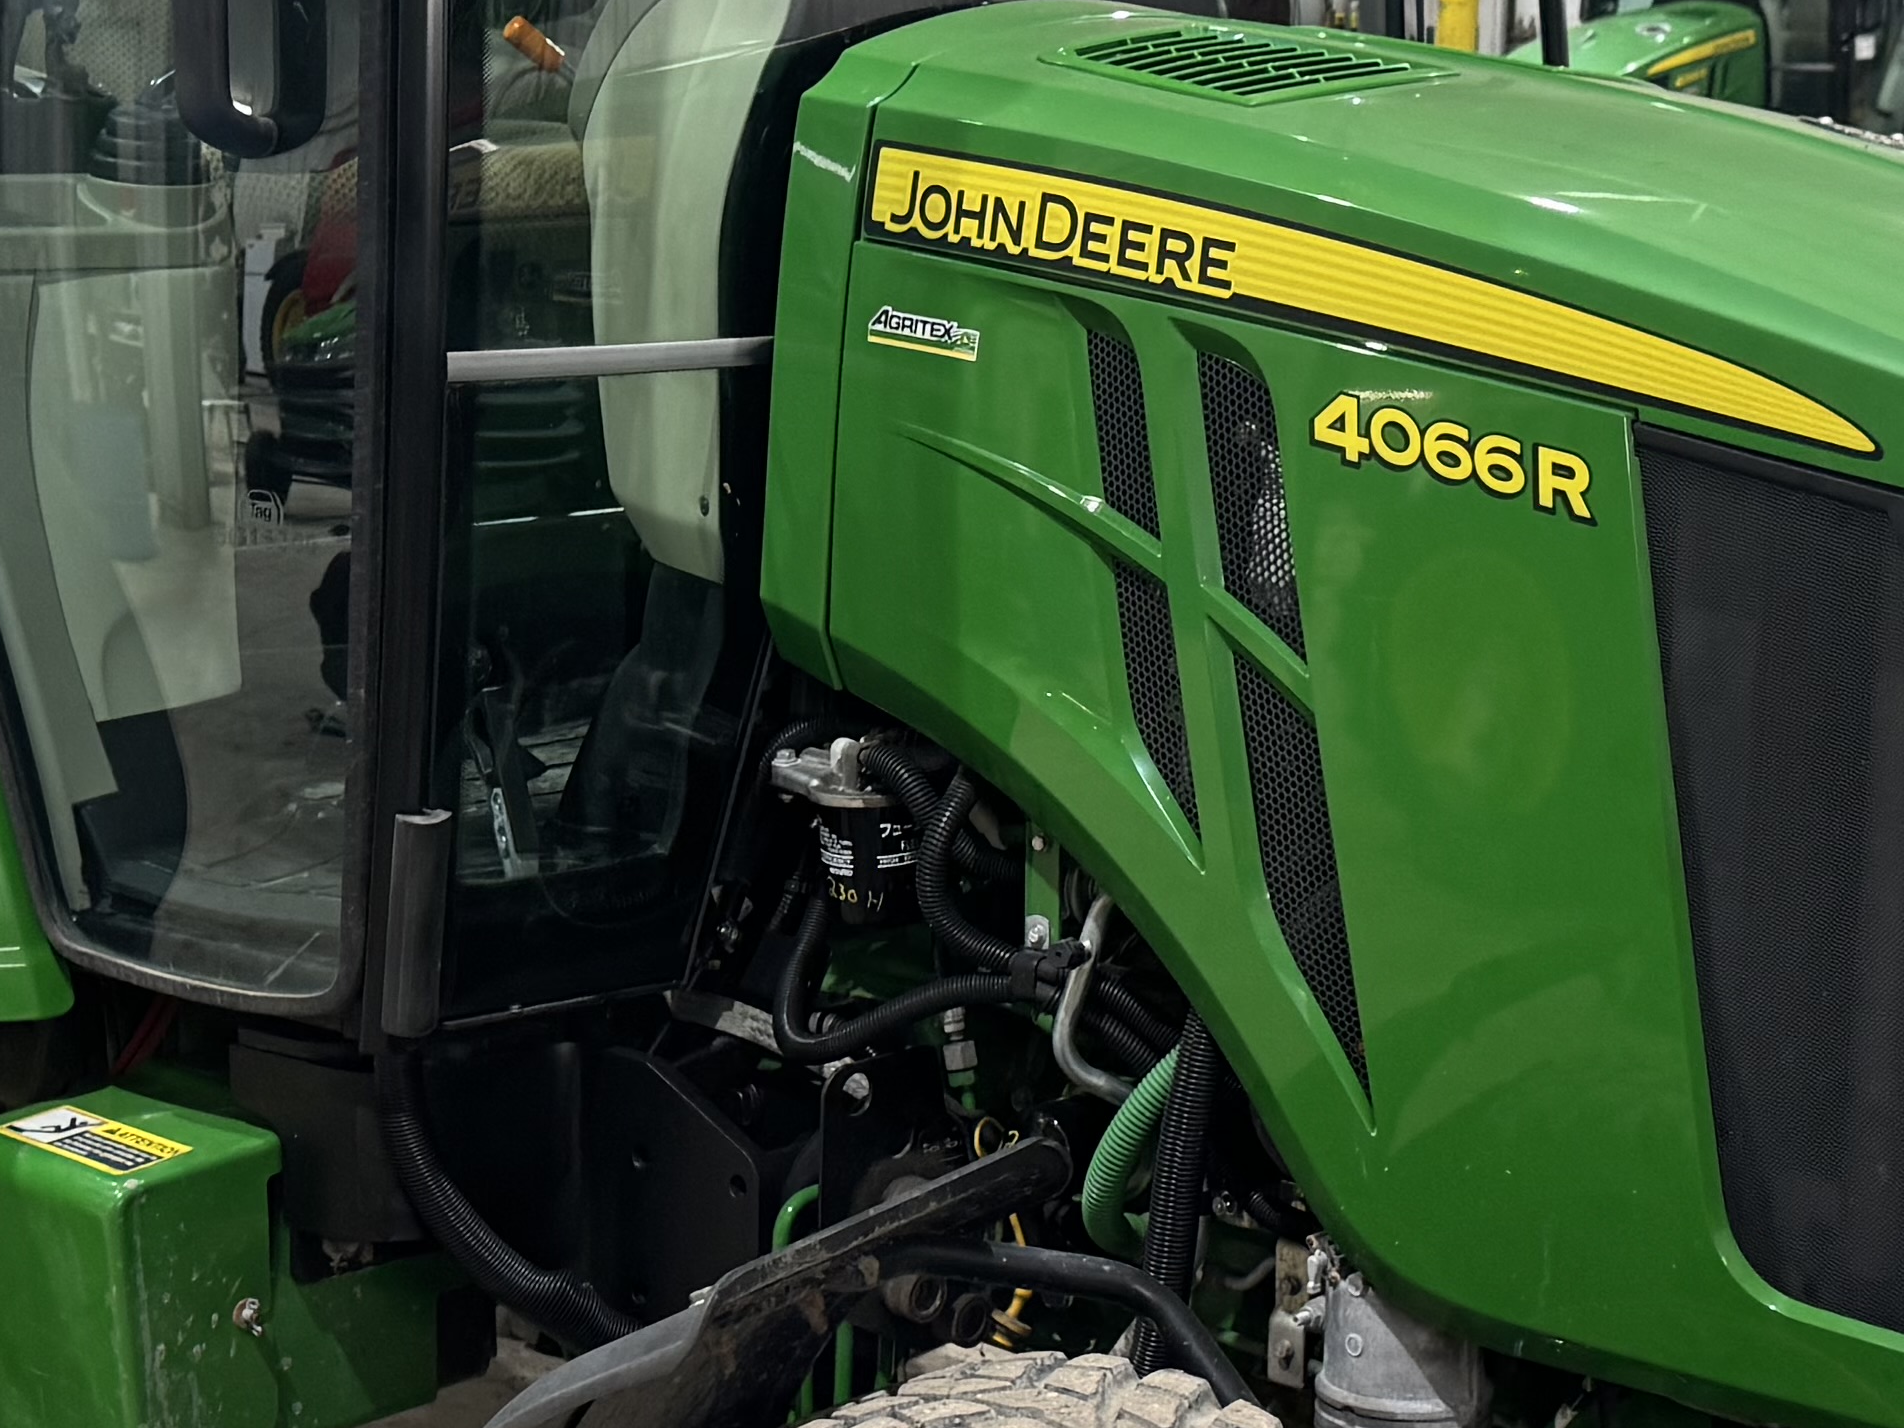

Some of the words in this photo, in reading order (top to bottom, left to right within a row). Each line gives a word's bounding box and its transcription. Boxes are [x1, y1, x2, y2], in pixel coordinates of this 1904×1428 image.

[888, 169, 1027, 249] JOHN
[1034, 190, 1237, 292] DEERE
[870, 309, 954, 341] AGRITEX
